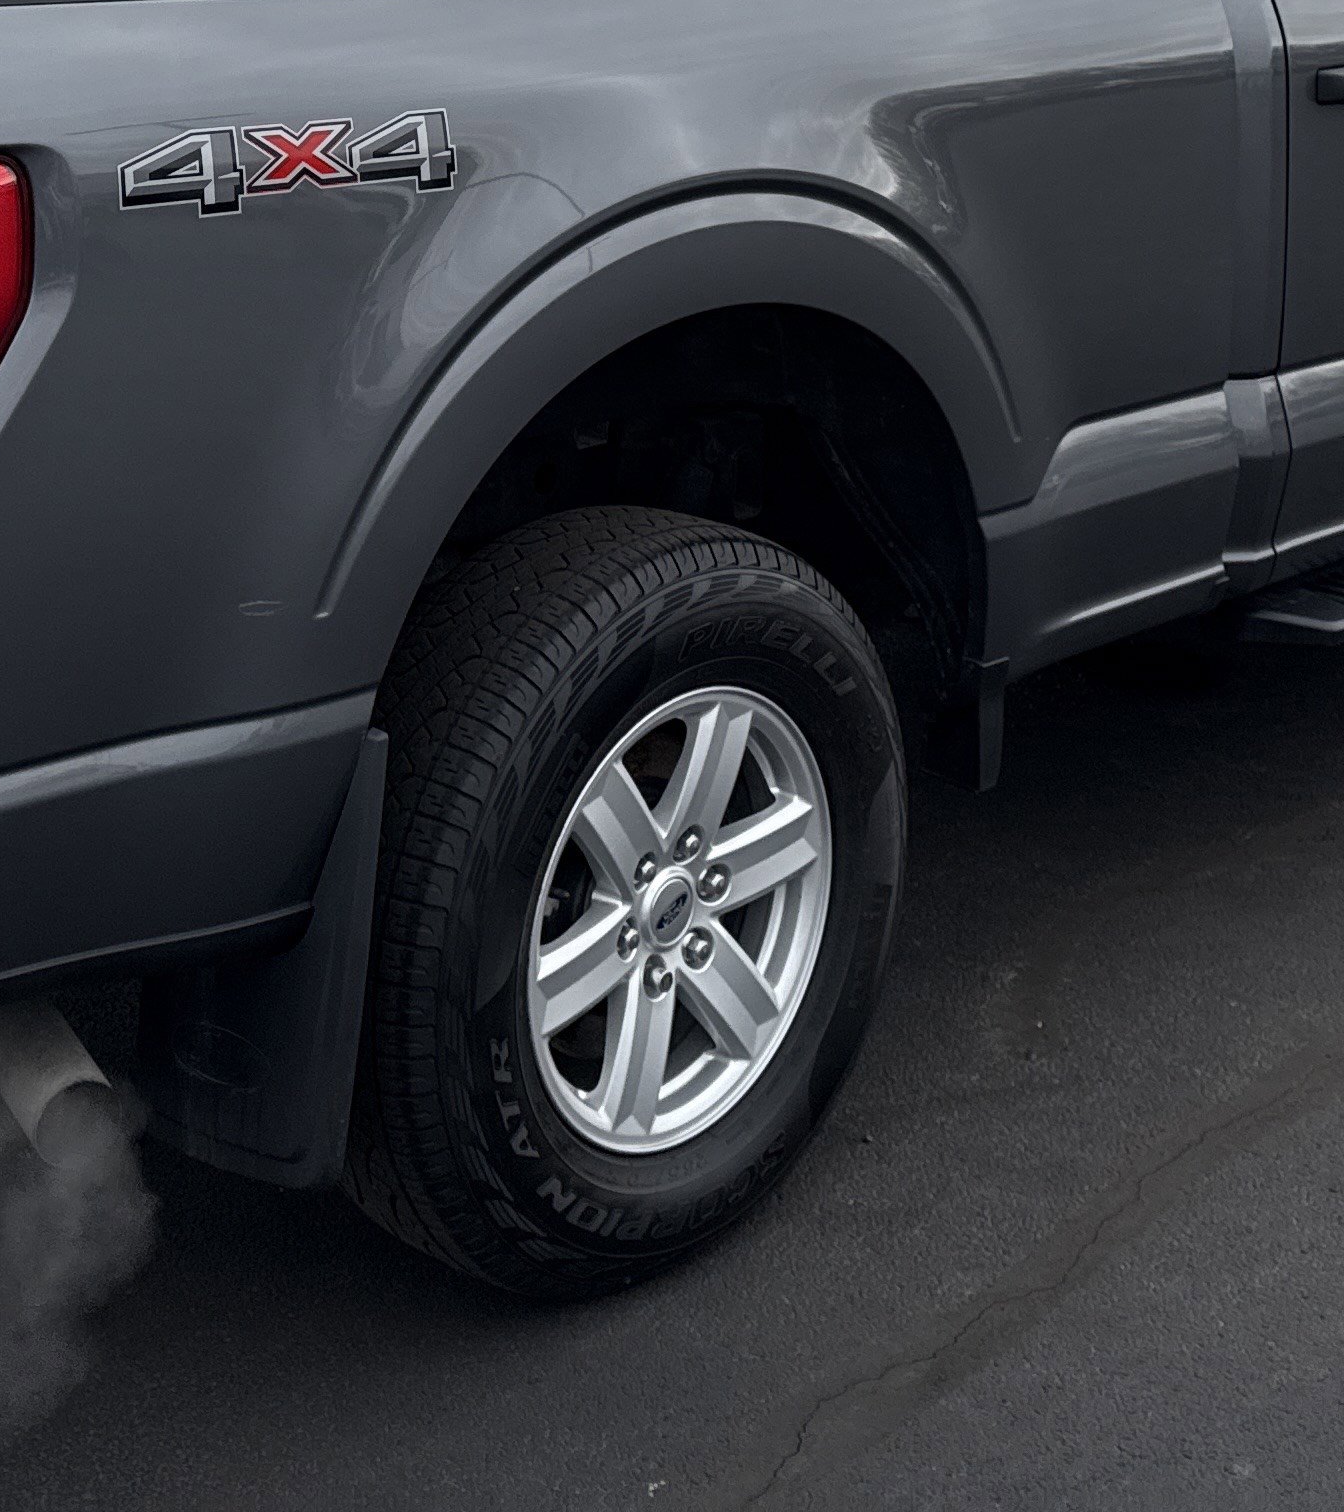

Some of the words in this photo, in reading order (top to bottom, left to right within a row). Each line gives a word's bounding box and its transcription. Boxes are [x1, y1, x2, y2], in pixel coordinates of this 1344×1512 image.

[678, 615, 858, 696] PIRELLI
[490, 1037, 541, 1159] ATR
[536, 1130, 787, 1241] SCORPION
